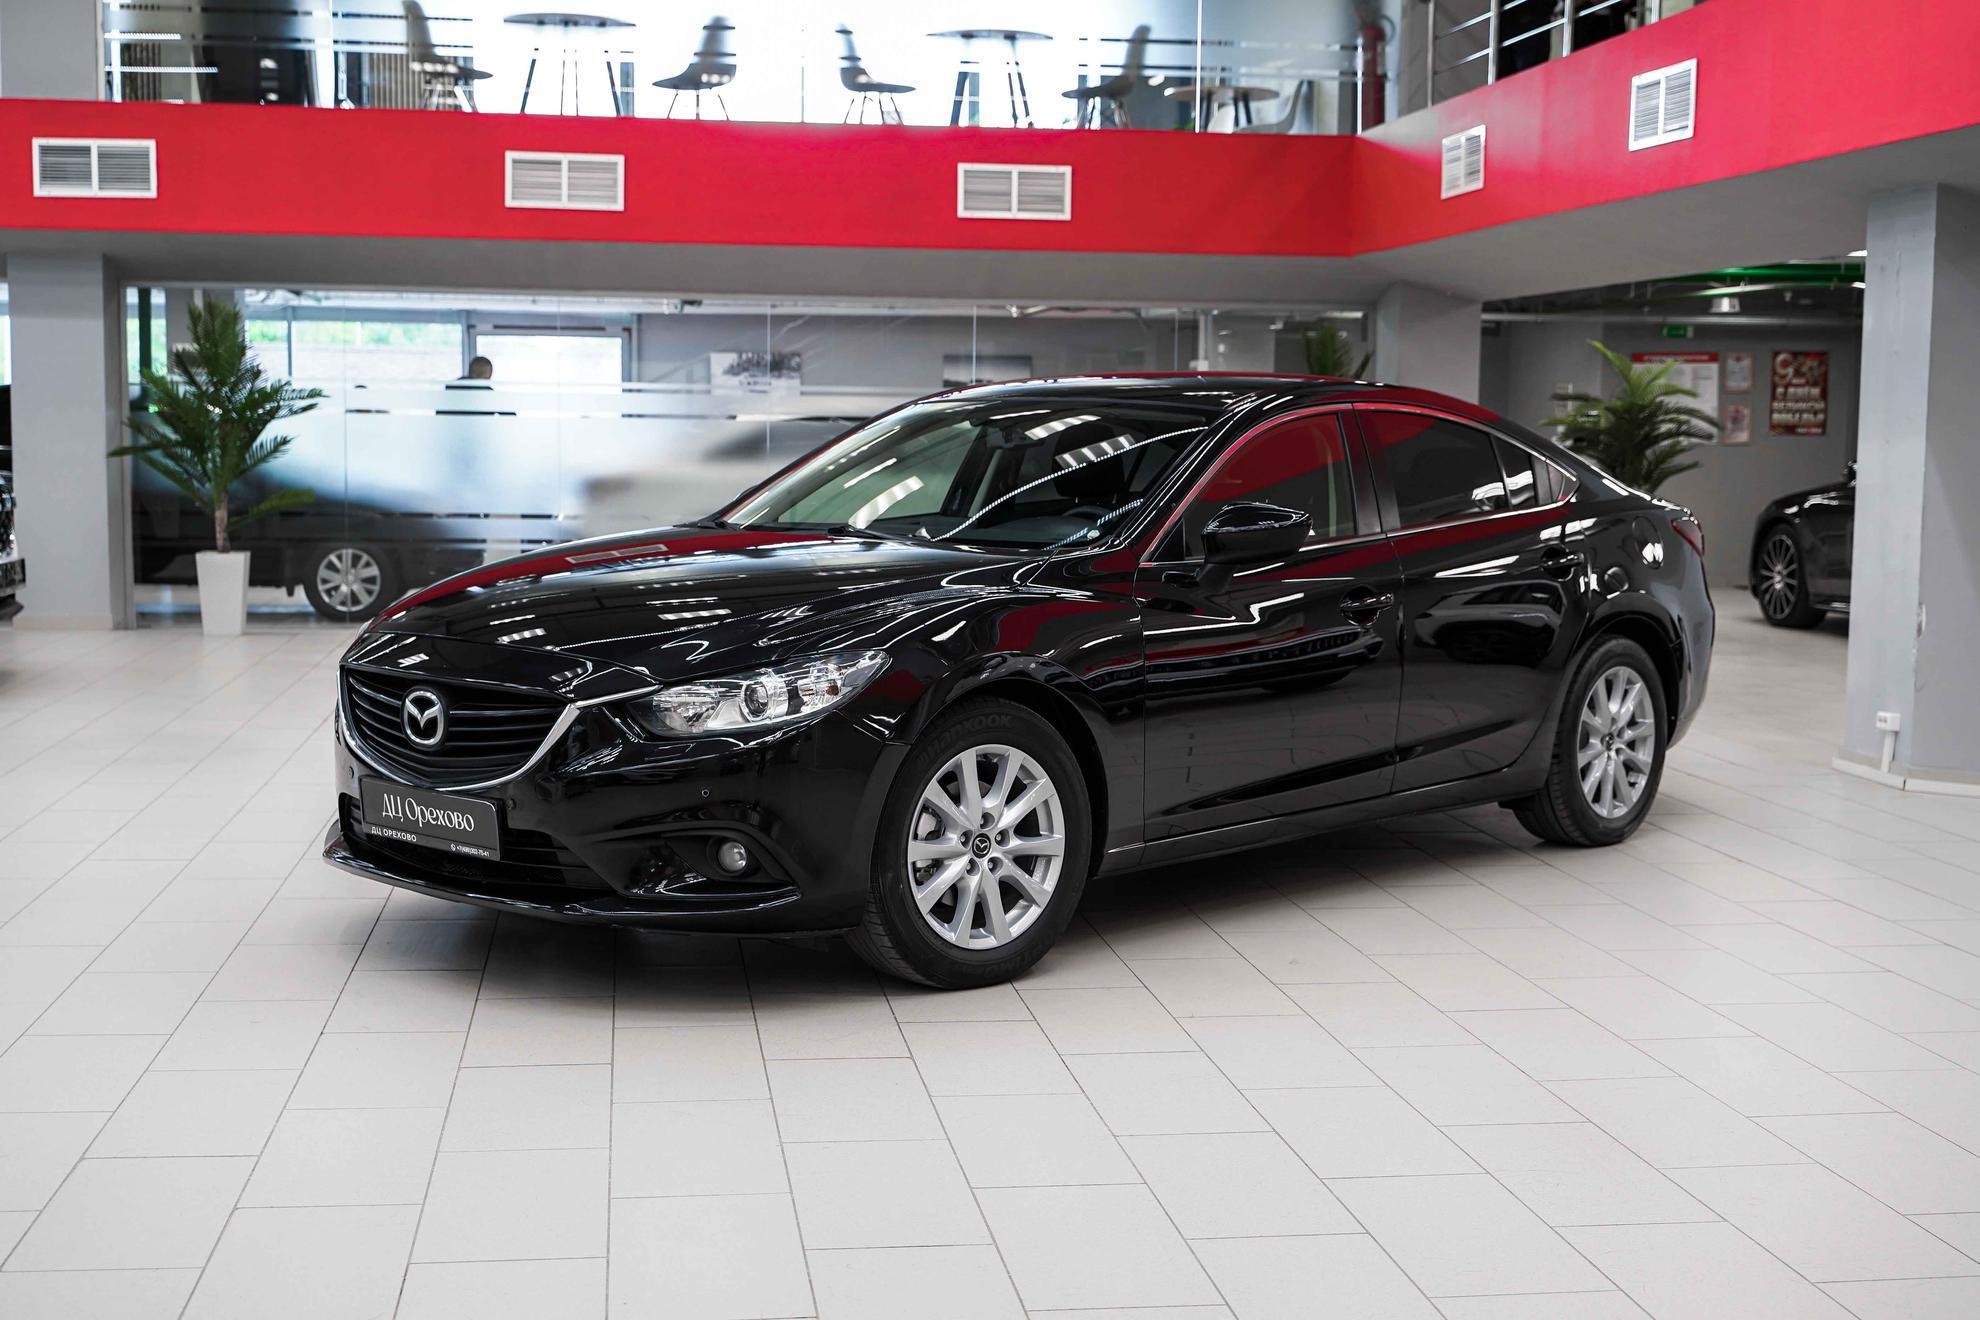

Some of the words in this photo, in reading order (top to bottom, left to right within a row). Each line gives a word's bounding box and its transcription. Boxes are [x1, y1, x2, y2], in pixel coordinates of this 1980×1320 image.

[382, 793, 404, 822] ДЦ
[405, 797, 475, 832] Орехово
[371, 826, 382, 836] ДЦ
[382, 829, 417, 843] ОРЕХОВО
